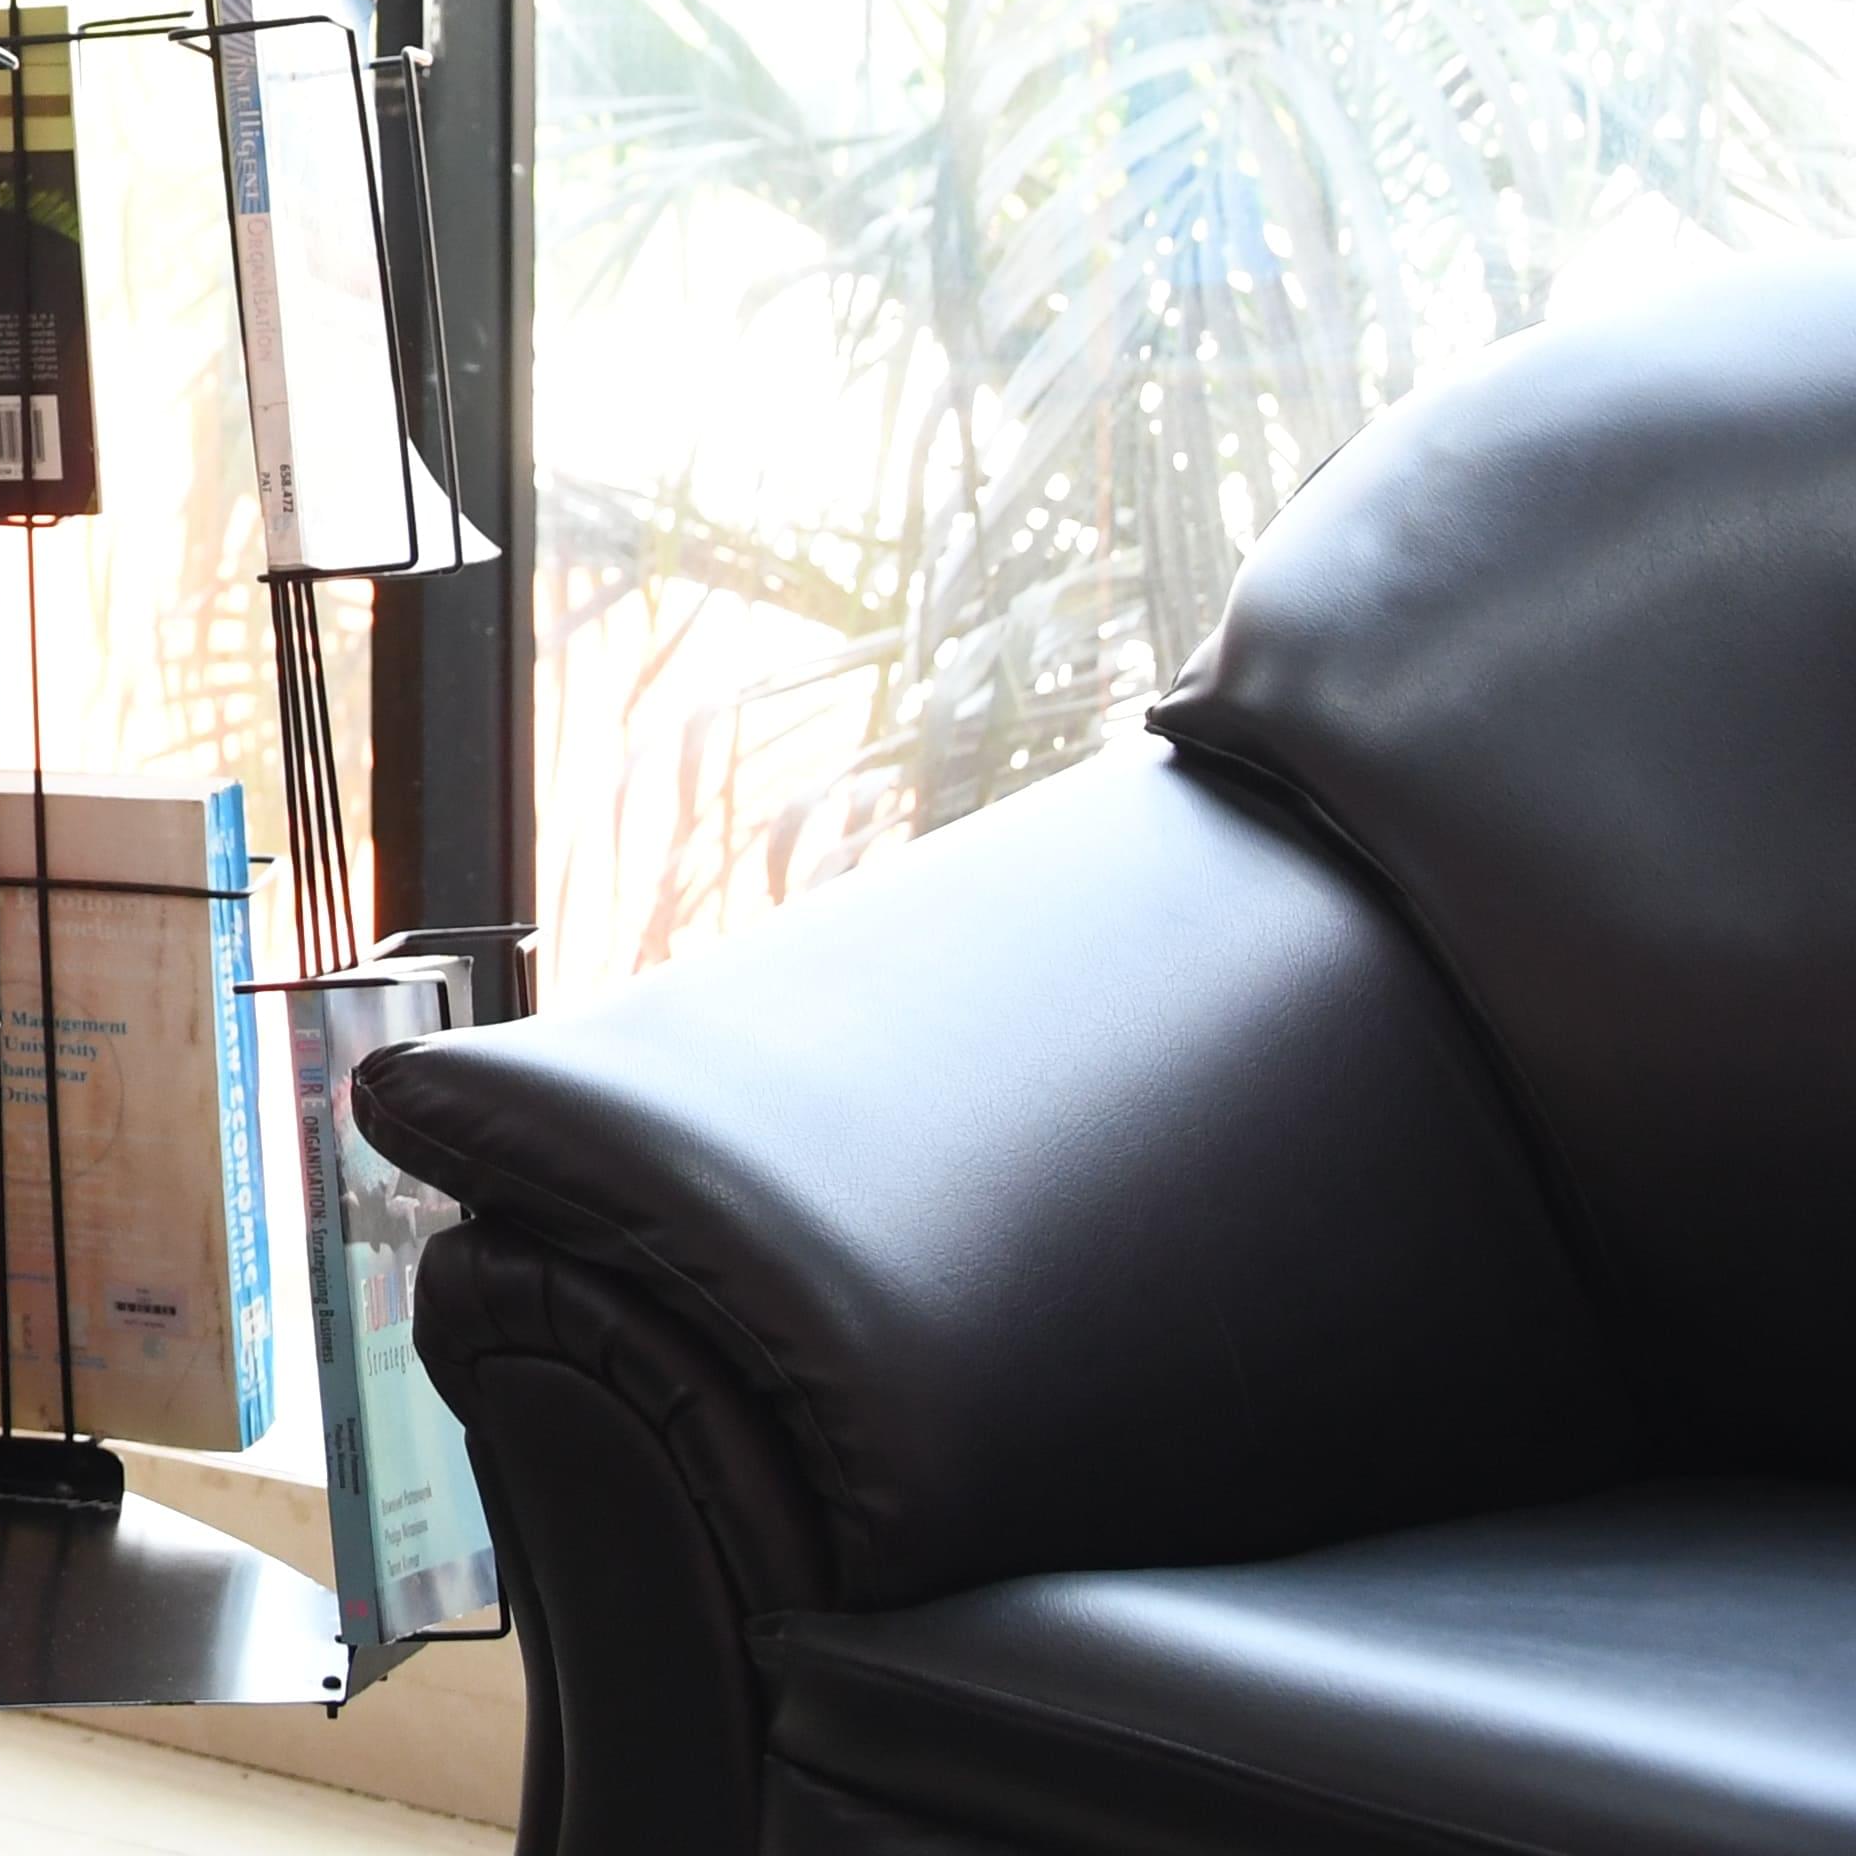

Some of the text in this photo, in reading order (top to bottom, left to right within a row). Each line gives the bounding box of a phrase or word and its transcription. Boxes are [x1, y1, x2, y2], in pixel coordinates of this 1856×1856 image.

[261, 471, 272, 495] PAT
[279, 463, 294, 514] 658.472
[12, 1011, 128, 1036] Maagement
[227, 1074, 258, 1285] ECONOMIC
[309, 1226, 330, 1306] Strategising
[317, 1302, 336, 1366] Business
